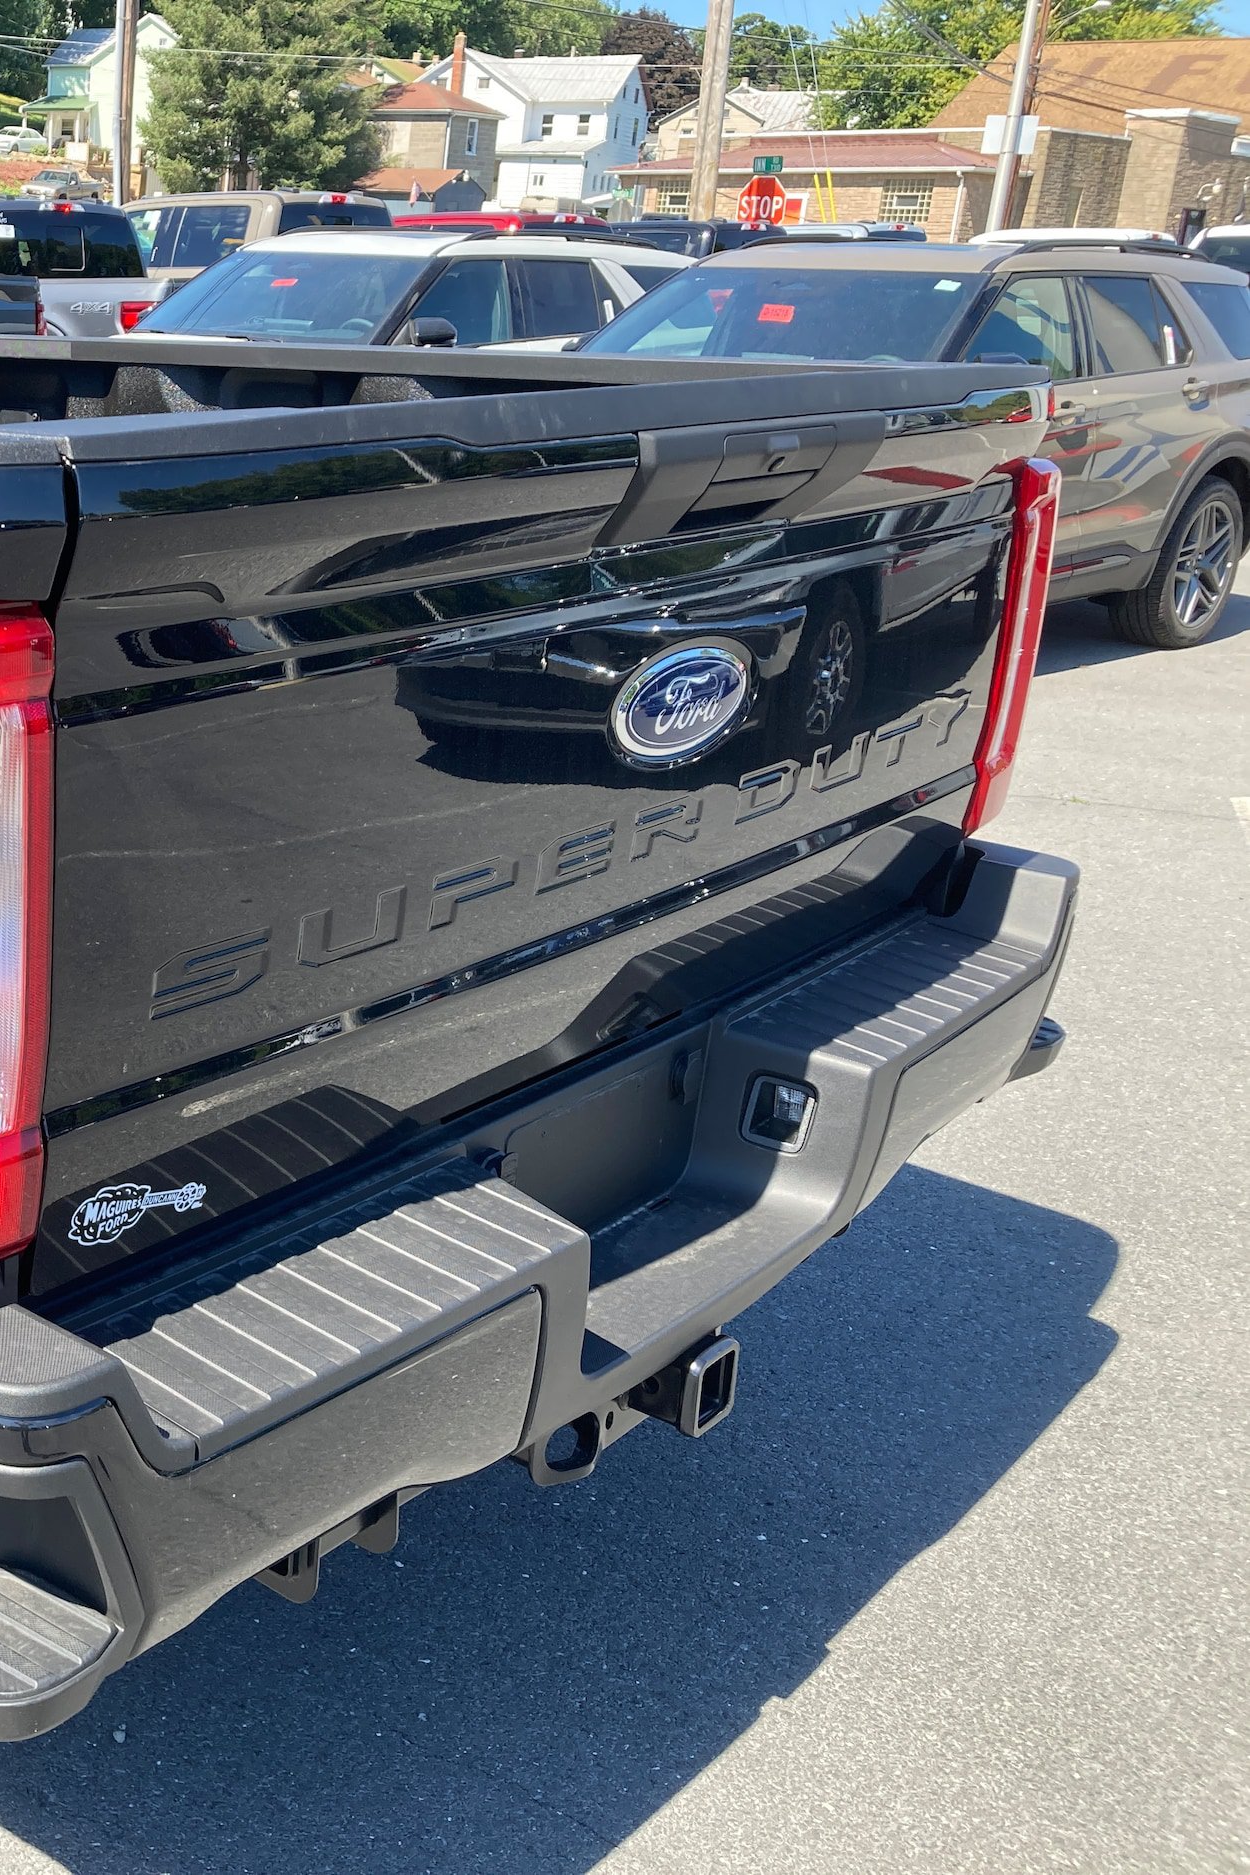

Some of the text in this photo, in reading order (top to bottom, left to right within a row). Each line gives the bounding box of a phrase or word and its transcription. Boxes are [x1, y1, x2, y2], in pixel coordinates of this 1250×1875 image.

[739, 195, 783, 219] STOP
[654, 671, 726, 736] Ford
[150, 688, 972, 1020] SUPER DUTY
[96, 1214, 128, 1238] FORD
